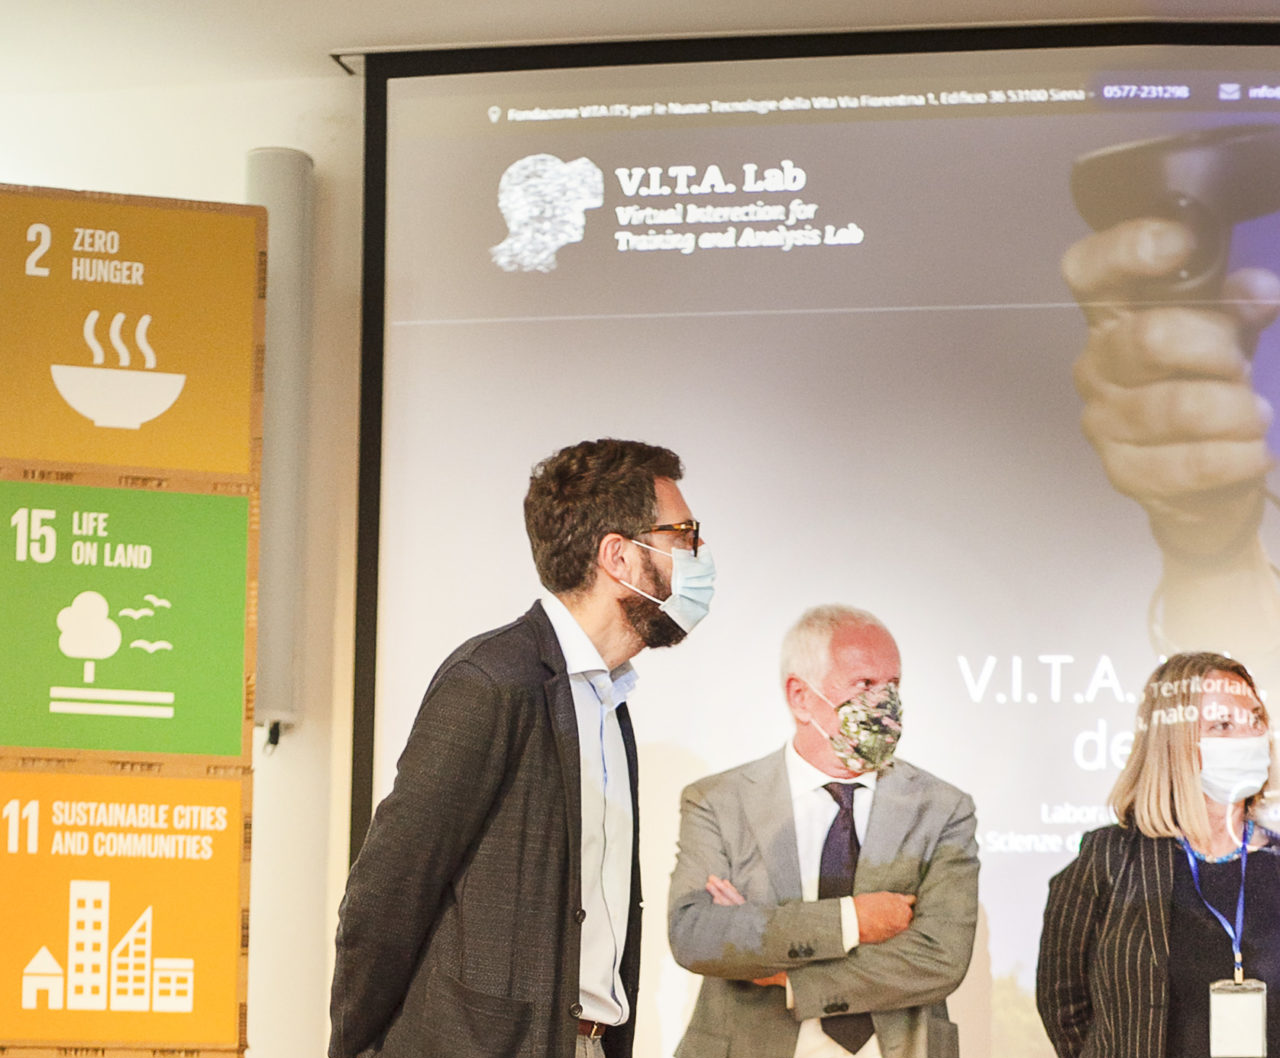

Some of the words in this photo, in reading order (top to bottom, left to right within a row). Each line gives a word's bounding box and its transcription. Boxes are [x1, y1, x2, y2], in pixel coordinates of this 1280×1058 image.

[1007, 89, 1048, 102] 53100
[614, 164, 736, 197] V.I.T.A.
[742, 159, 806, 192] Lab
[614, 203, 683, 225] Virtual
[785, 198, 818, 226] for
[25, 223, 51, 277] 2
[72, 228, 120, 254] ZERO
[614, 229, 696, 254] Training
[698, 226, 736, 248] and
[737, 224, 821, 251] Analysis
[824, 222, 864, 245] Lab
[71, 257, 145, 285] HUNGER
[10, 507, 57, 563] 15
[72, 511, 109, 537] LIFE
[71, 541, 98, 566] ON
[103, 543, 152, 569] LAND
[957, 653, 1136, 703] V.I.T.A.
[2, 799, 40, 854] 11
[51, 801, 169, 829] SUSTAINABLE
[173, 805, 228, 831] CITIES
[51, 831, 89, 856] AND
[93, 832, 213, 860] COMMUNITIES
